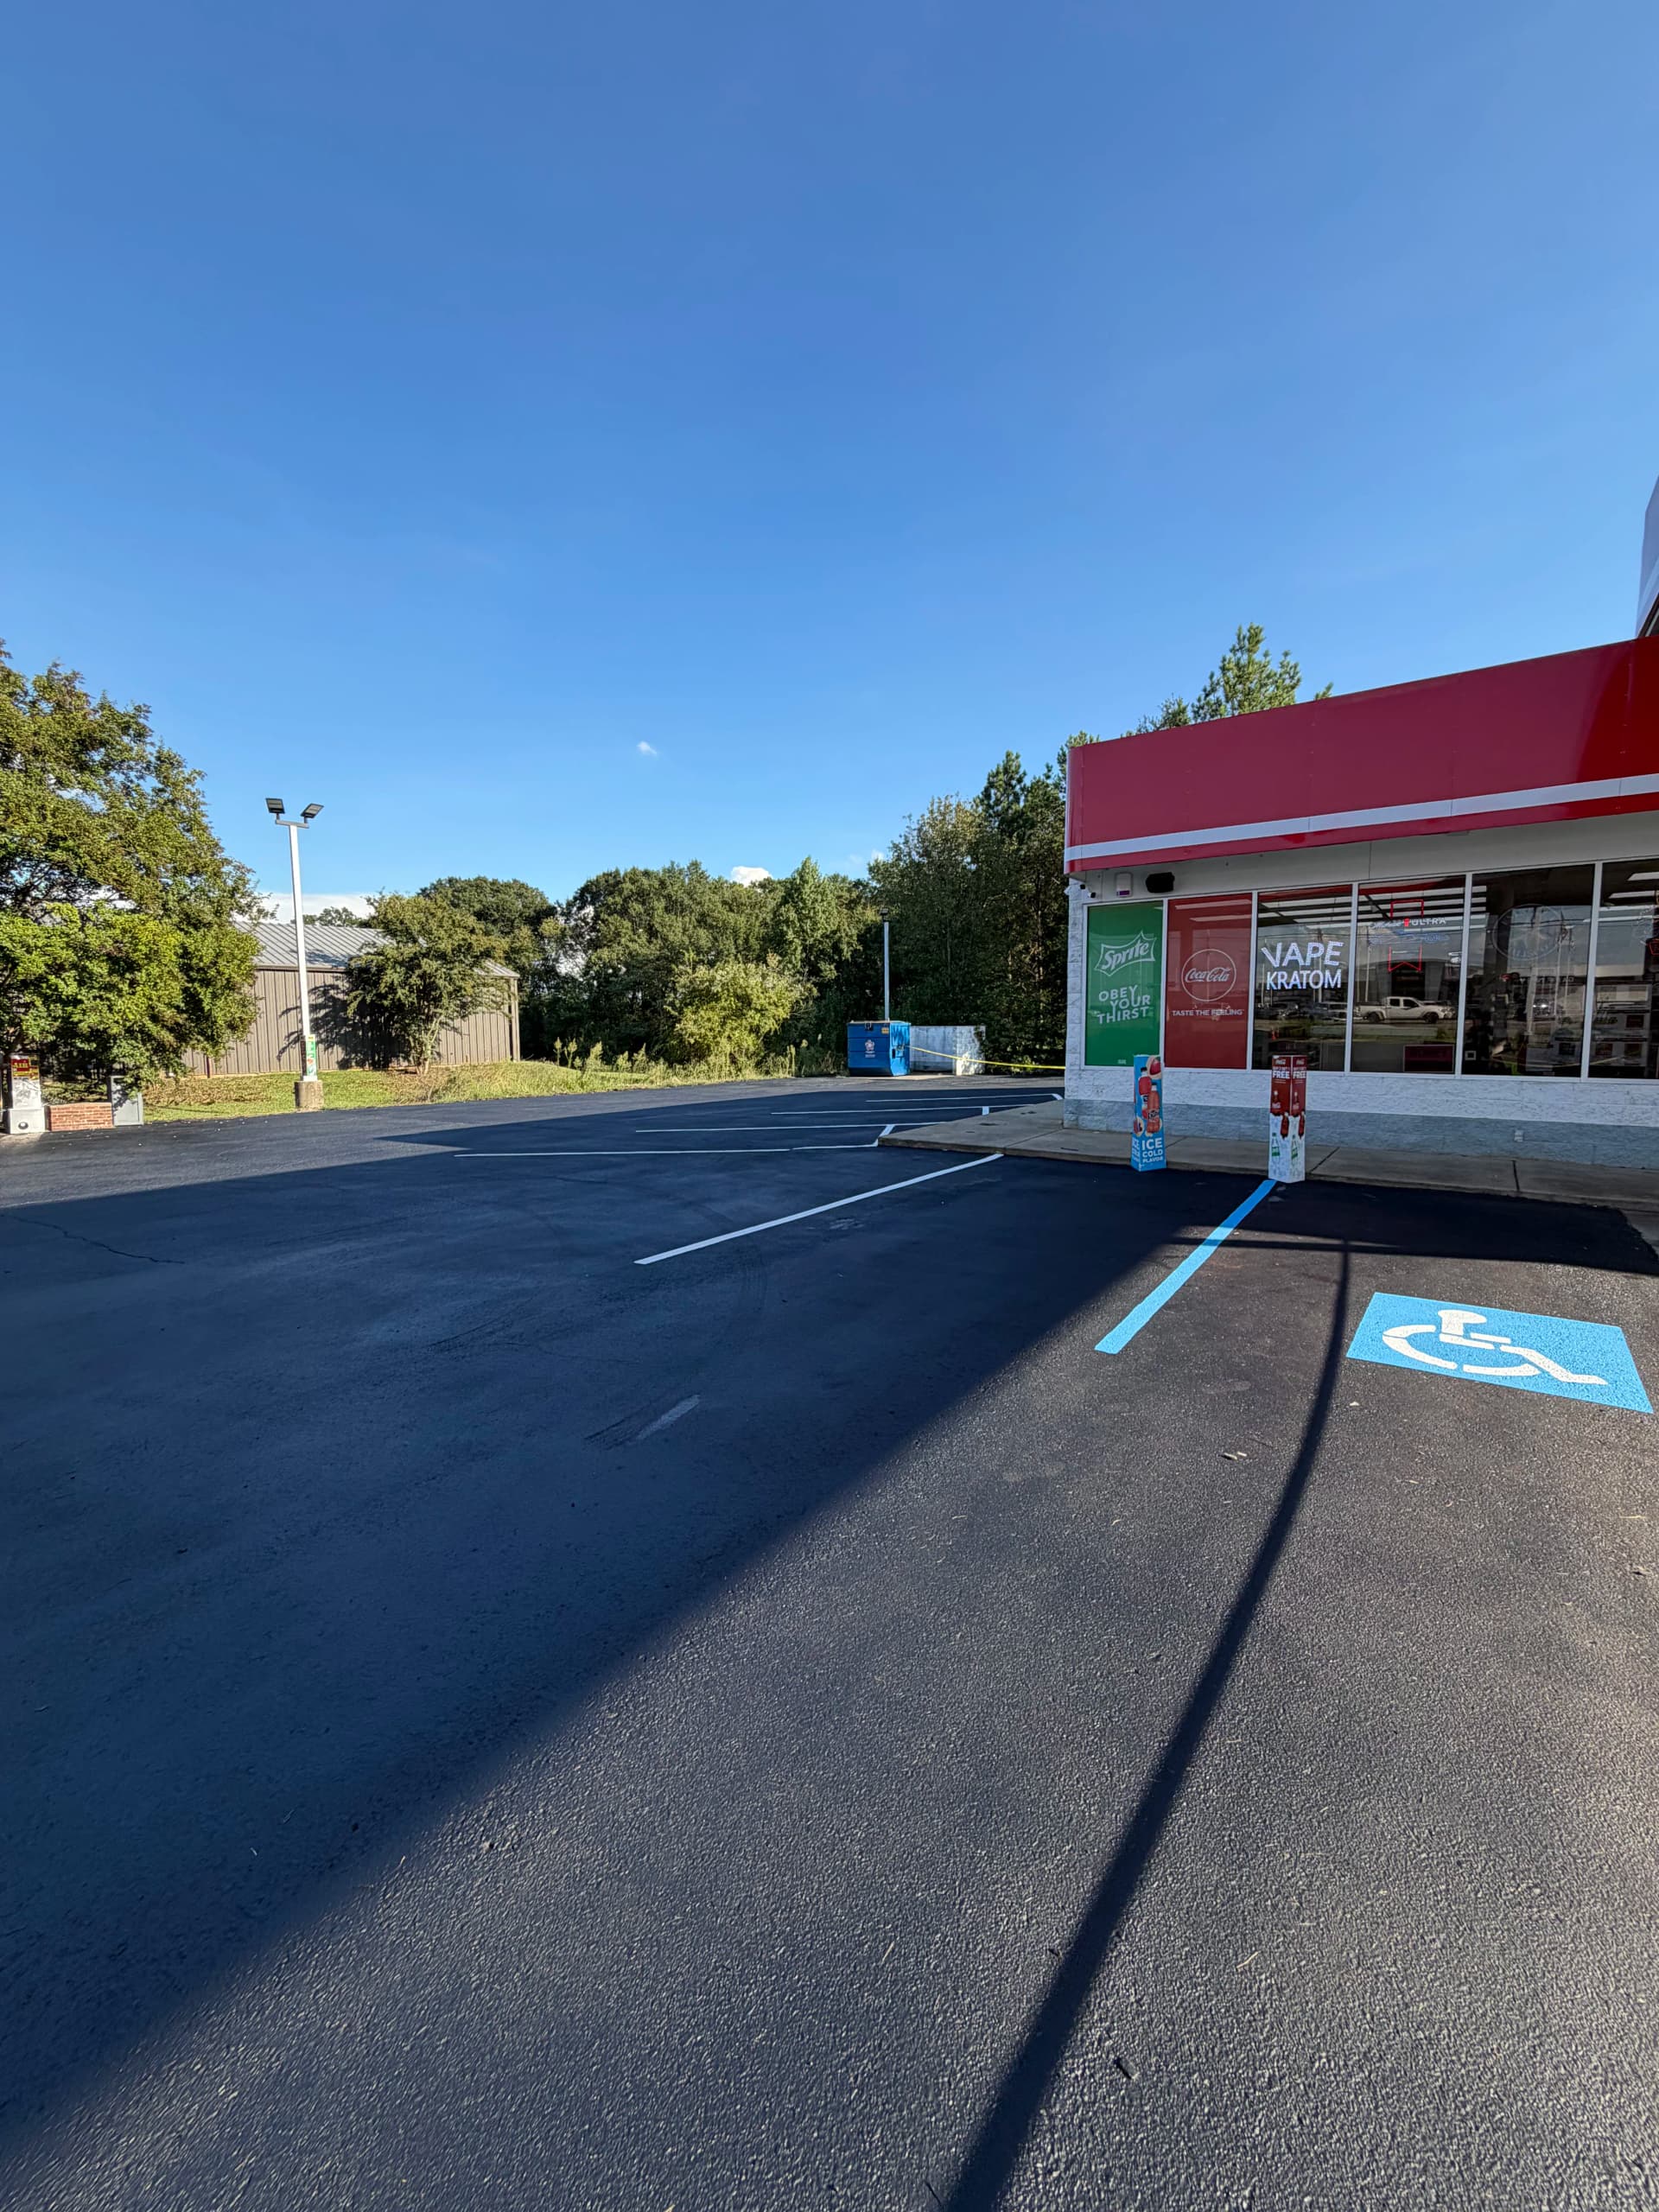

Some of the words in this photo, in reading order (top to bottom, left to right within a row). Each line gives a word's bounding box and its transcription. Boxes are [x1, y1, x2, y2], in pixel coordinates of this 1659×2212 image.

[1102, 938, 1150, 970] Sprite
[1262, 940, 1344, 969] VAPE
[1265, 969, 1342, 990] KRATOM
[1098, 985, 1139, 1002] OBEY
[1110, 995, 1151, 1010] YOUR
[1097, 1007, 1148, 1024] THIRST
[1272, 1071, 1291, 1079] FREE
[1293, 1071, 1307, 1079] FREE
[1141, 1137, 1162, 1150] ICE
[1142, 1149, 1163, 1158] COLD
